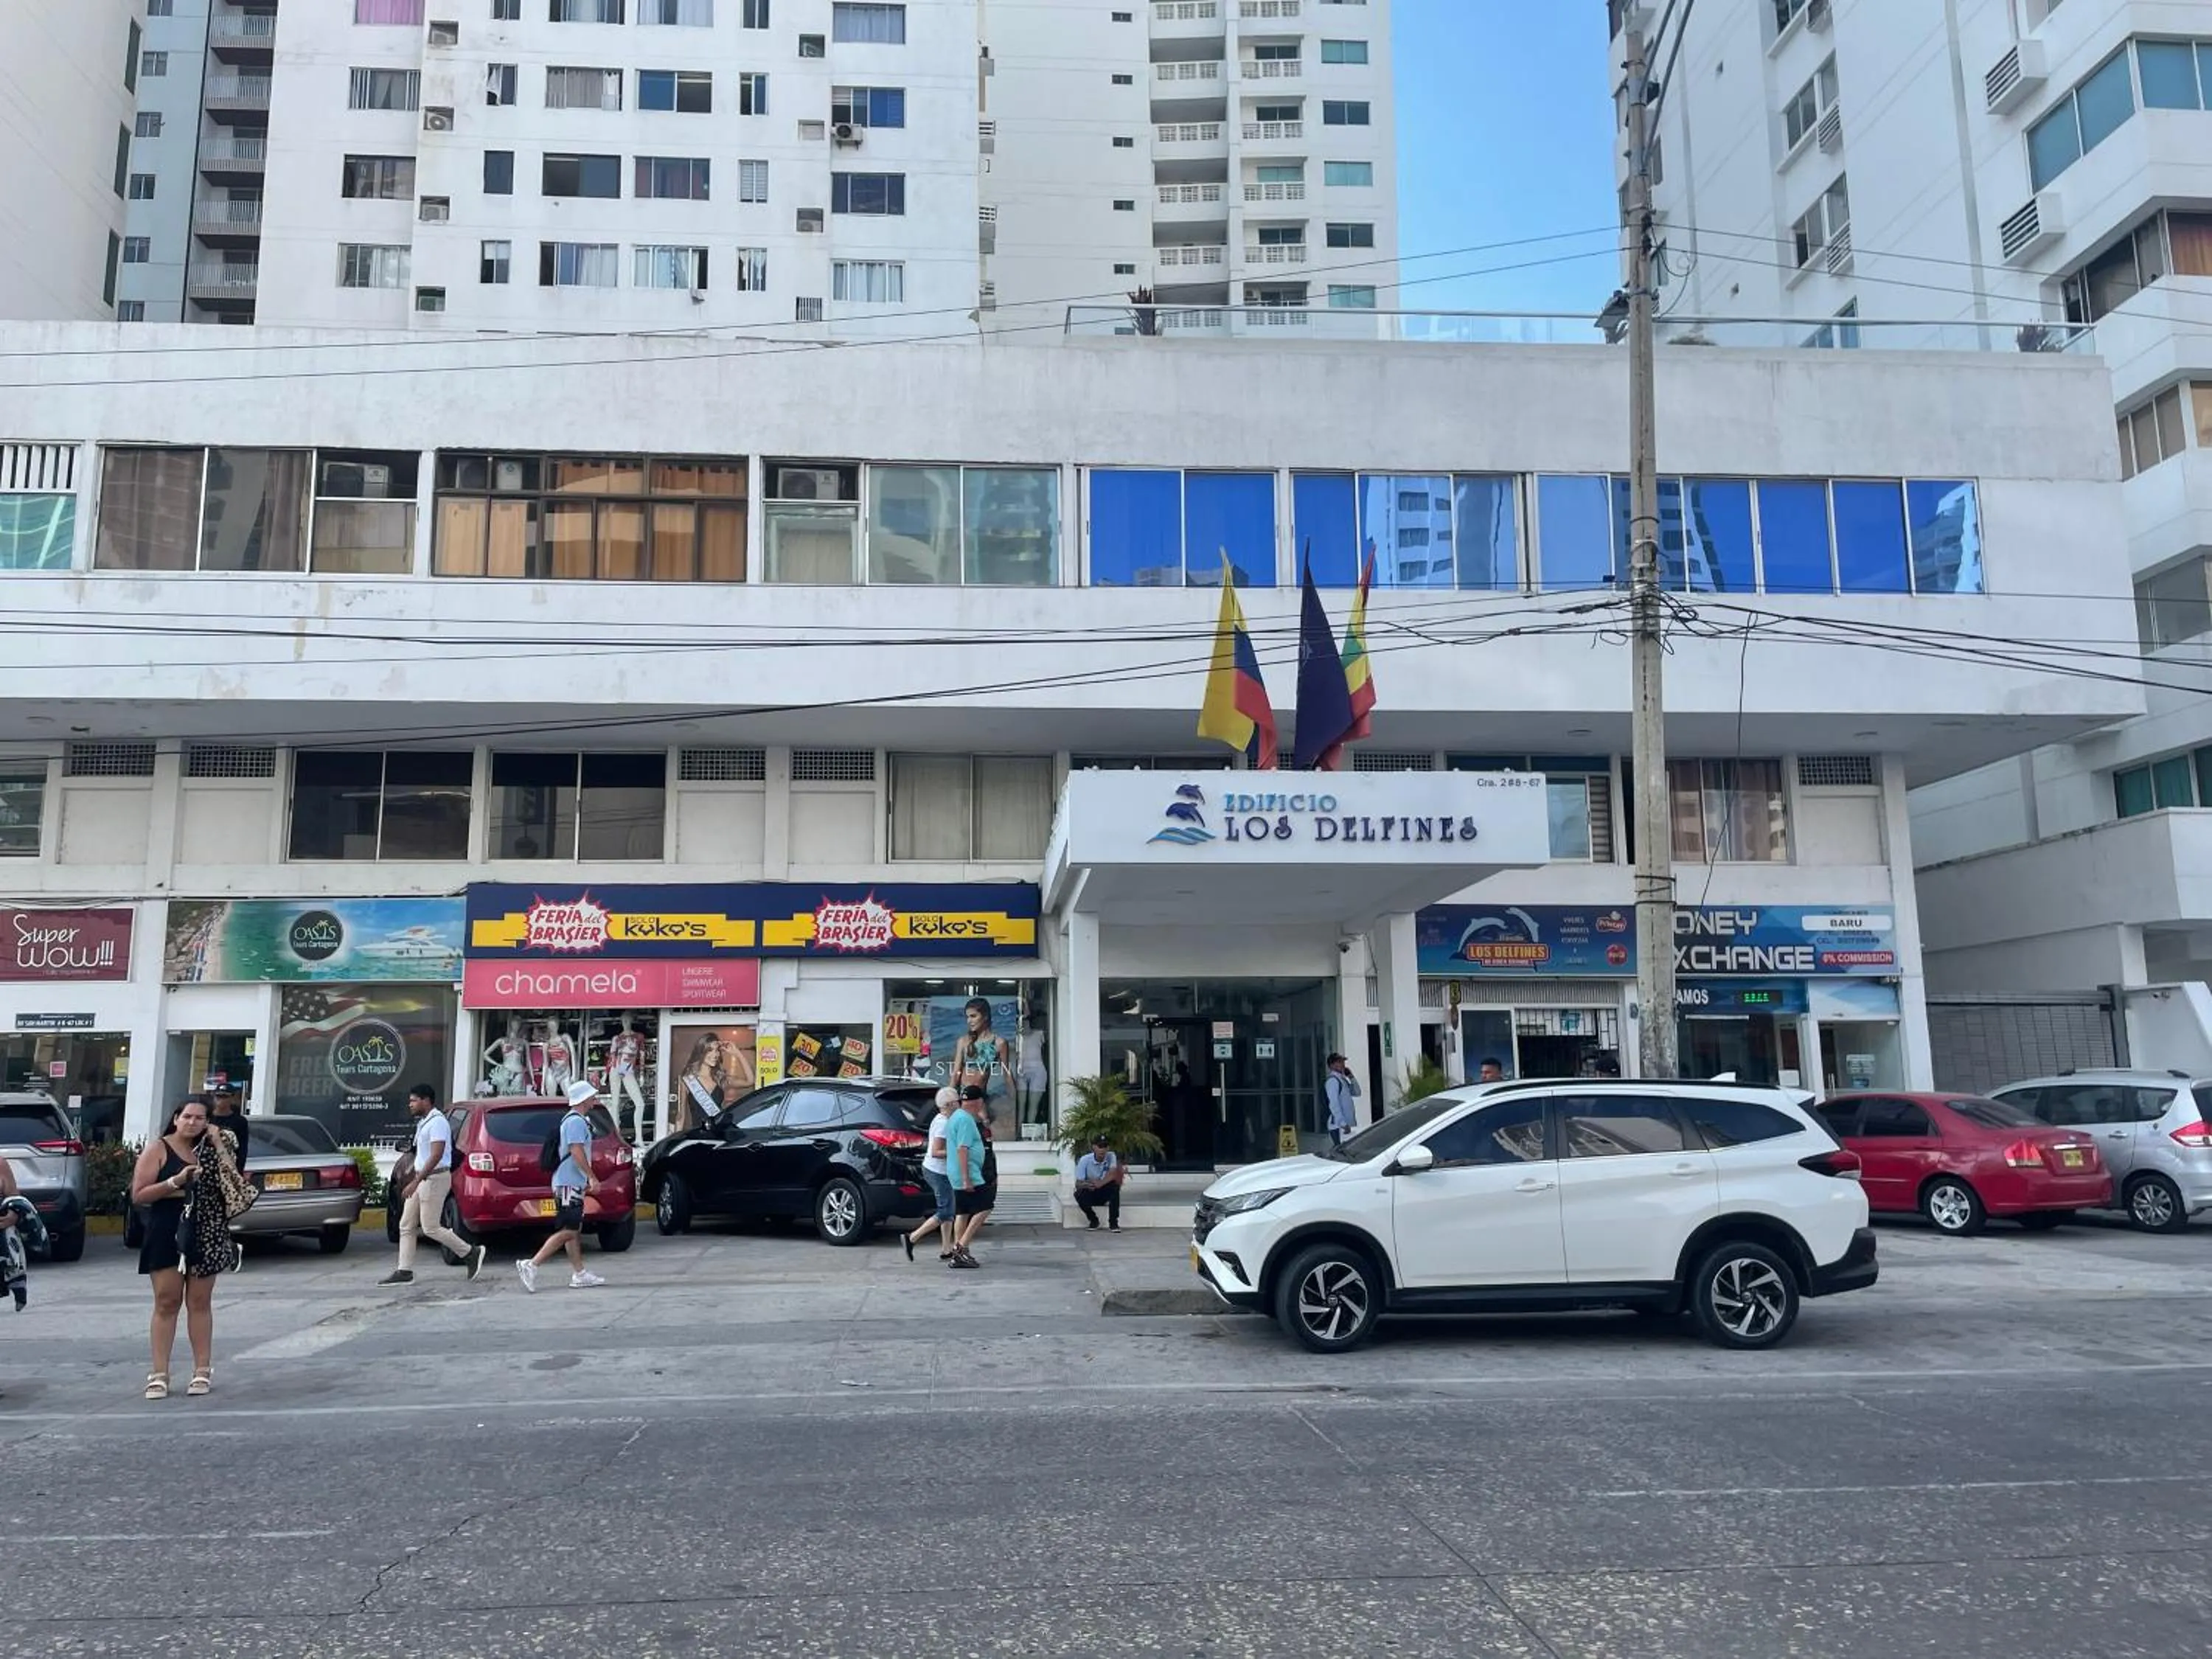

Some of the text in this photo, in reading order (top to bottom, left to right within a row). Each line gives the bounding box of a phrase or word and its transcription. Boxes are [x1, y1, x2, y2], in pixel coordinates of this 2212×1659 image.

[1224, 793, 1337, 812] EDIFICIO
[1225, 815, 1478, 841] LOS DELFINES
[535, 908, 602, 926] FERIA del
[823, 907, 869, 925] FERIA
[1674, 911, 1758, 935] ONEY
[13, 914, 80, 947] Super
[294, 922, 337, 940] OASIS
[532, 925, 602, 944] BRASIER
[821, 924, 887, 942] BRASIER
[1470, 946, 1545, 958] LOS DELFINES
[1674, 945, 1815, 970] XCHANGE
[495, 969, 637, 995] chamela
[1677, 989, 1709, 1004] AMOS
[886, 1015, 918, 1039] 20%
[338, 1037, 394, 1063] OASIS
